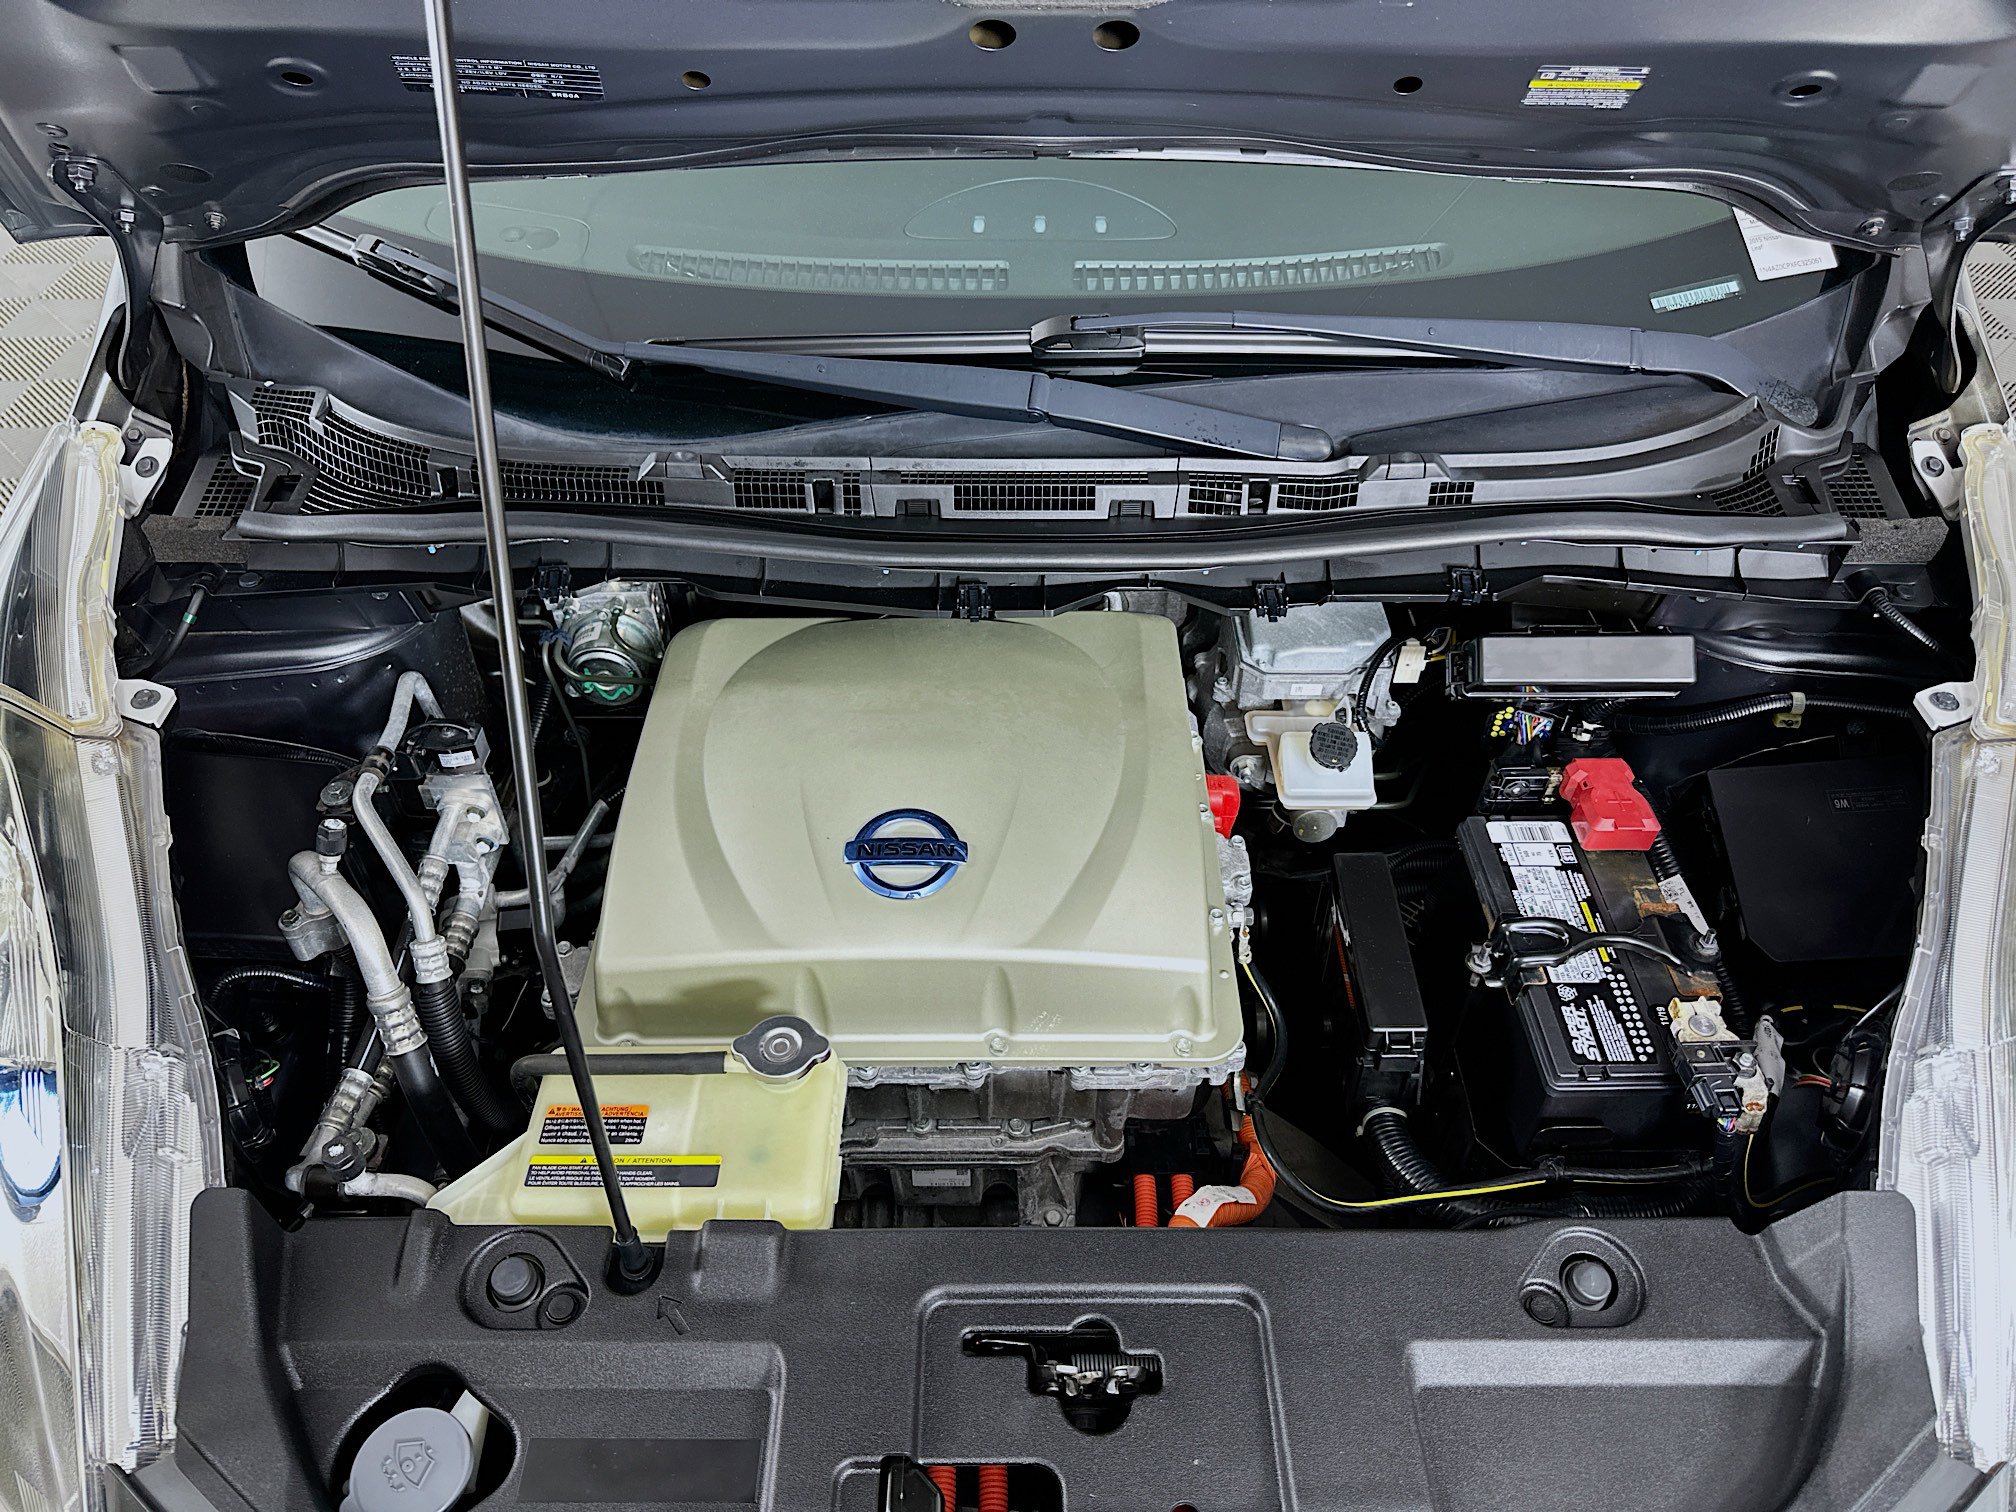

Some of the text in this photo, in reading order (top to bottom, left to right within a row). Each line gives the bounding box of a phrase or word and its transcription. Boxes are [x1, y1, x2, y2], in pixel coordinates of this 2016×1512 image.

[1764, 235, 1782, 243] Nissan
[856, 842, 955, 857] NISSAN
[1656, 1006, 1670, 1026] 11/19
[1561, 1006, 1584, 1055] SUPER
[1571, 1003, 1602, 1062] START
